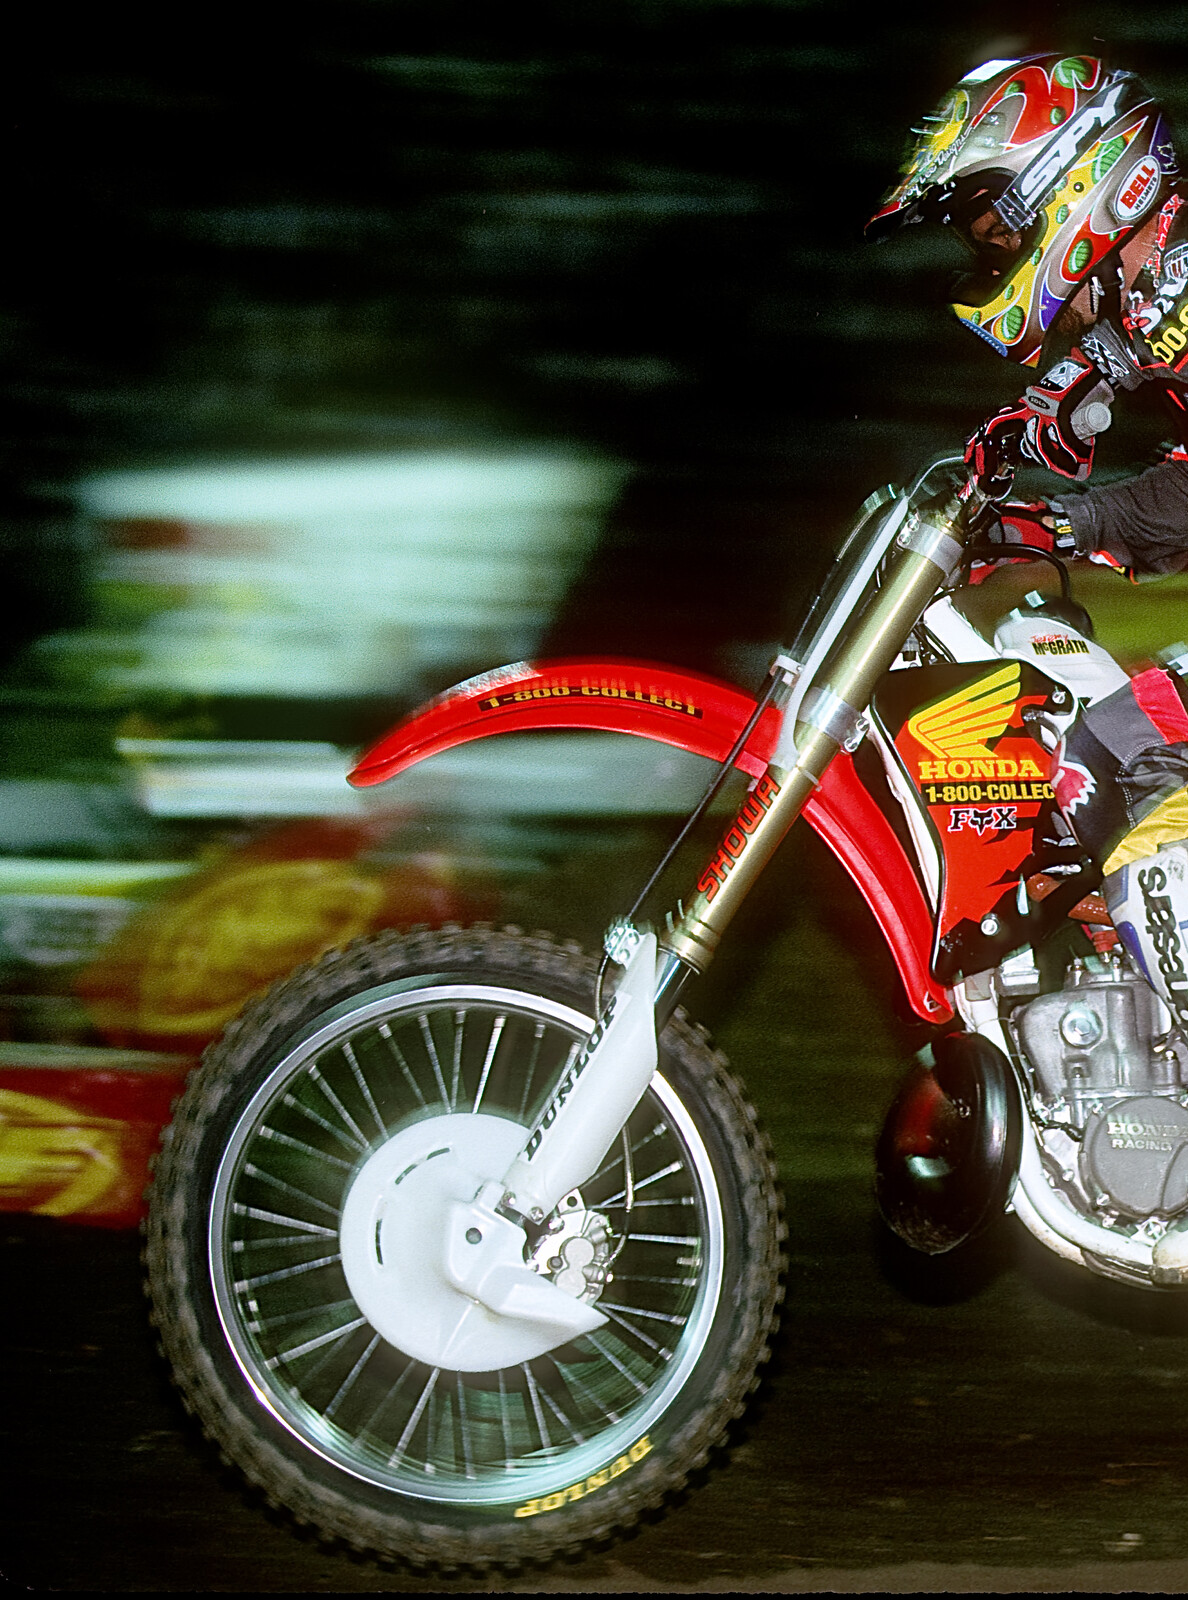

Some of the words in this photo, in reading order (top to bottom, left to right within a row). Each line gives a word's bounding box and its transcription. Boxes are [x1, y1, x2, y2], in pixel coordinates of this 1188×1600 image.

[1021, 84, 1124, 205] SPY
[1120, 165, 1155, 209] BELL
[1134, 177, 1157, 210] HELMETS
[484, 686, 698, 716] 1-800-COLLECT
[918, 760, 1044, 780] HONDA
[697, 774, 781, 903] SHOWA
[526, 994, 618, 1163] DUNLOP
[1112, 1138, 1172, 1151] RACING
